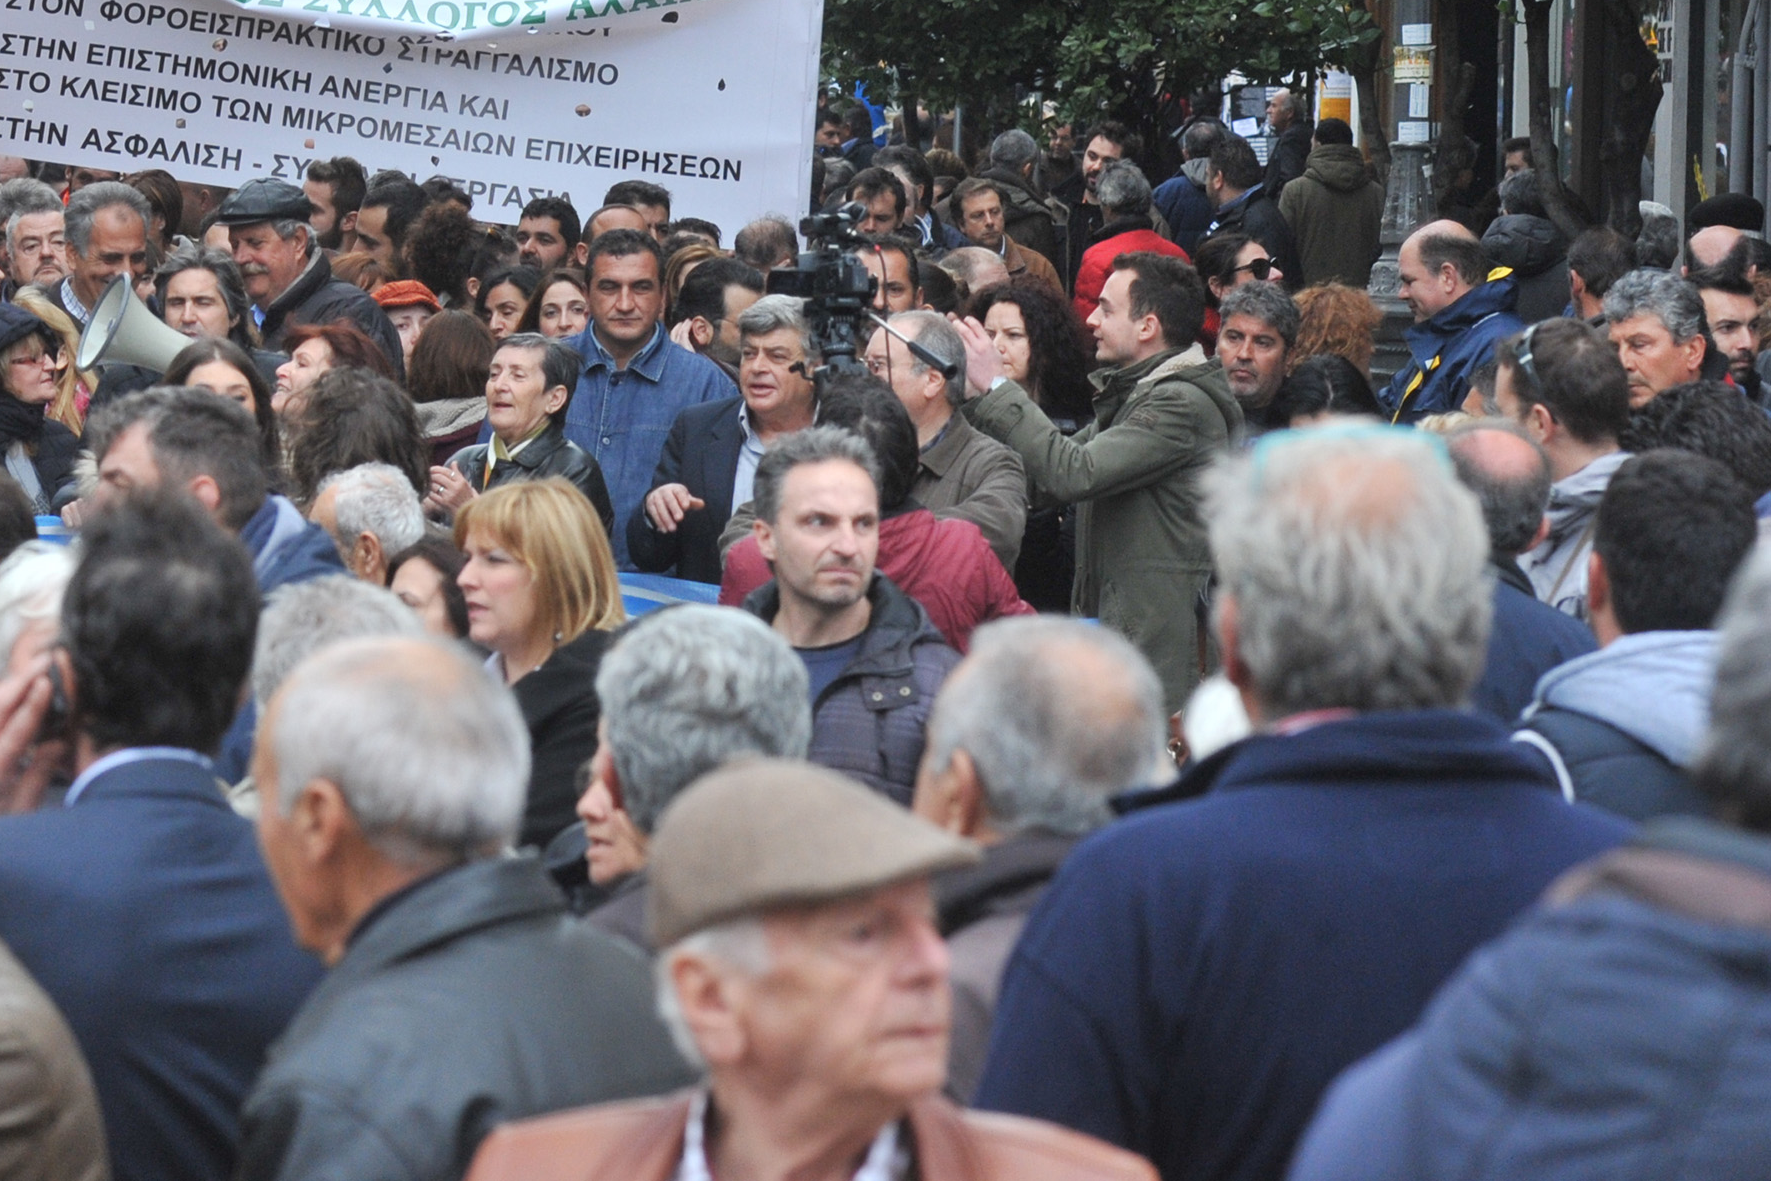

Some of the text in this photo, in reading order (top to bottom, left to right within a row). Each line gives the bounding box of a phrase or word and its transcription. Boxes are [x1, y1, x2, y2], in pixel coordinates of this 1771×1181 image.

[0, 33, 77, 61] ΣΤΗΝ
[86, 43, 312, 93] ΕΠΙΣΤΗΜΟΝΙΚΗ
[319, 75, 448, 113] ΑΝΕΡΓΙΑ
[459, 94, 509, 120] ΚΑΙ
[100, 0, 385, 57] ΦΟΡΟΕΙΣΠΡΑΚΤΙΚΟ
[397, 38, 619, 86] ΣΤΡΑΓΓΑΛΙΣΜΟ
[60, 75, 202, 114] ΚΛΕΙΣΙΜΟ
[212, 95, 273, 119] ΤΩΝ
[283, 104, 516, 157] ΜΙΚΡΟΜΕΣΑΙΩΝ
[525, 138, 742, 182] ΕΠΙΧΕΙΡΗΣΕΩΝ
[81, 127, 242, 172] ΑΣΦΑΛΙΣΗ
